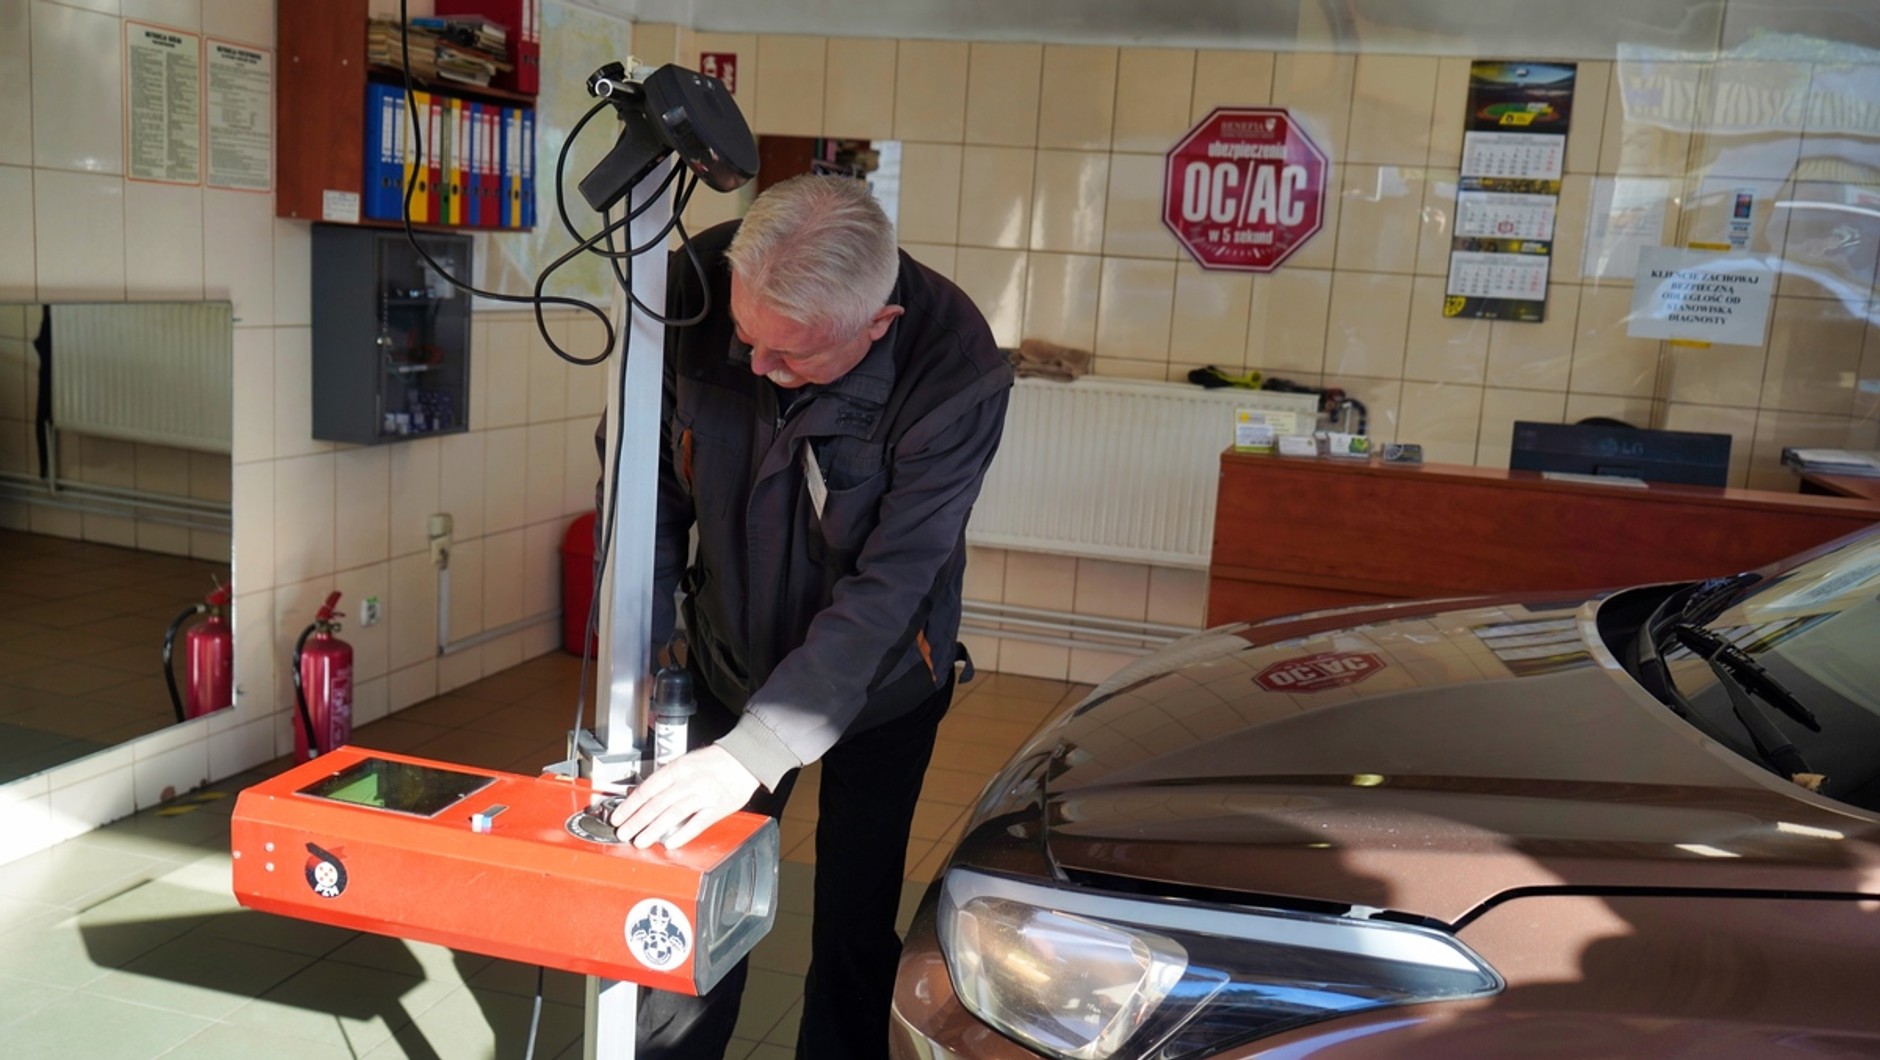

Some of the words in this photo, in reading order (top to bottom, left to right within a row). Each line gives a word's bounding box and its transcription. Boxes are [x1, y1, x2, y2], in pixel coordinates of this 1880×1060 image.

[1182, 160, 1307, 228] OC/AC
[1208, 229, 1220, 242] w
[1222, 228, 1231, 243] 5
[1233, 230, 1273, 245] sekund
[1702, 272, 1759, 284] ZACHOWAJ
[1671, 282, 1734, 294] BEZPIECZNĄ
[1725, 295, 1741, 304] OD
[1667, 303, 1733, 315] STANOWISKA
[1668, 313, 1726, 325] DIAGNOSTY
[1622, 442, 1644, 455] LG
